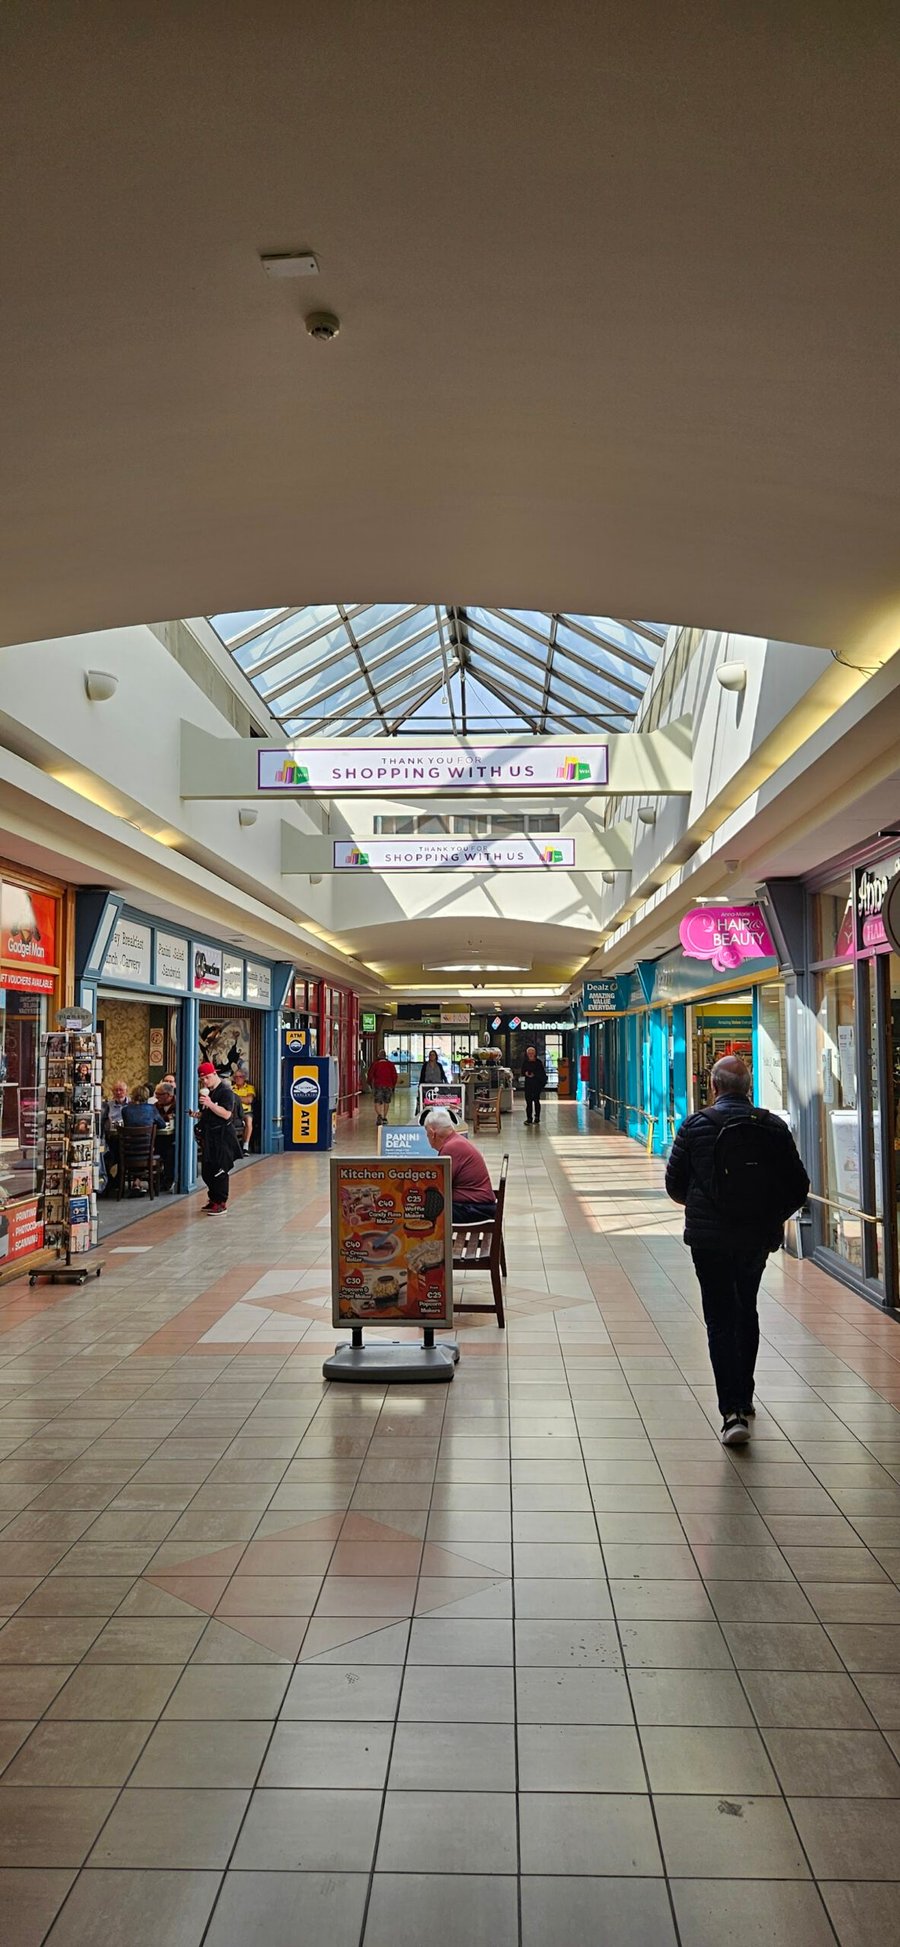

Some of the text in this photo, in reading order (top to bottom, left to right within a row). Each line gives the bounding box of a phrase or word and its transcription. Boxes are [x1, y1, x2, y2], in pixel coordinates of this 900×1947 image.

[381, 756, 481, 765] THANK YOU FOR
[331, 765, 535, 780] SHOPPING WITH US
[384, 852, 524, 862] SHOPPING WITH US
[717, 918, 750, 931] HAIR
[866, 921, 885, 942] HAI
[713, 932, 765, 947] BEAUTY
[8, 937, 45, 958] Gadget Man
[8, 974, 31, 986] VOUCHERS
[32, 977, 53, 989] AVAILABLE
[586, 983, 610, 991] Dealz
[301, 1110, 310, 1136] ATM
[385, 1133, 420, 1141] PANINI
[385, 1140, 412, 1148] DEAL
[340, 1169, 437, 1181] Kitchen Gadgets
[377, 1200, 394, 1208] €40
[406, 1196, 422, 1204] €25
[15, 1206, 37, 1222] PRINTING
[368, 1211, 387, 1219] Candy
[14, 1233, 39, 1251] SCANNING
[344, 1241, 361, 1249] €40
[345, 1277, 361, 1285] €30
[426, 1291, 442, 1299] €25
